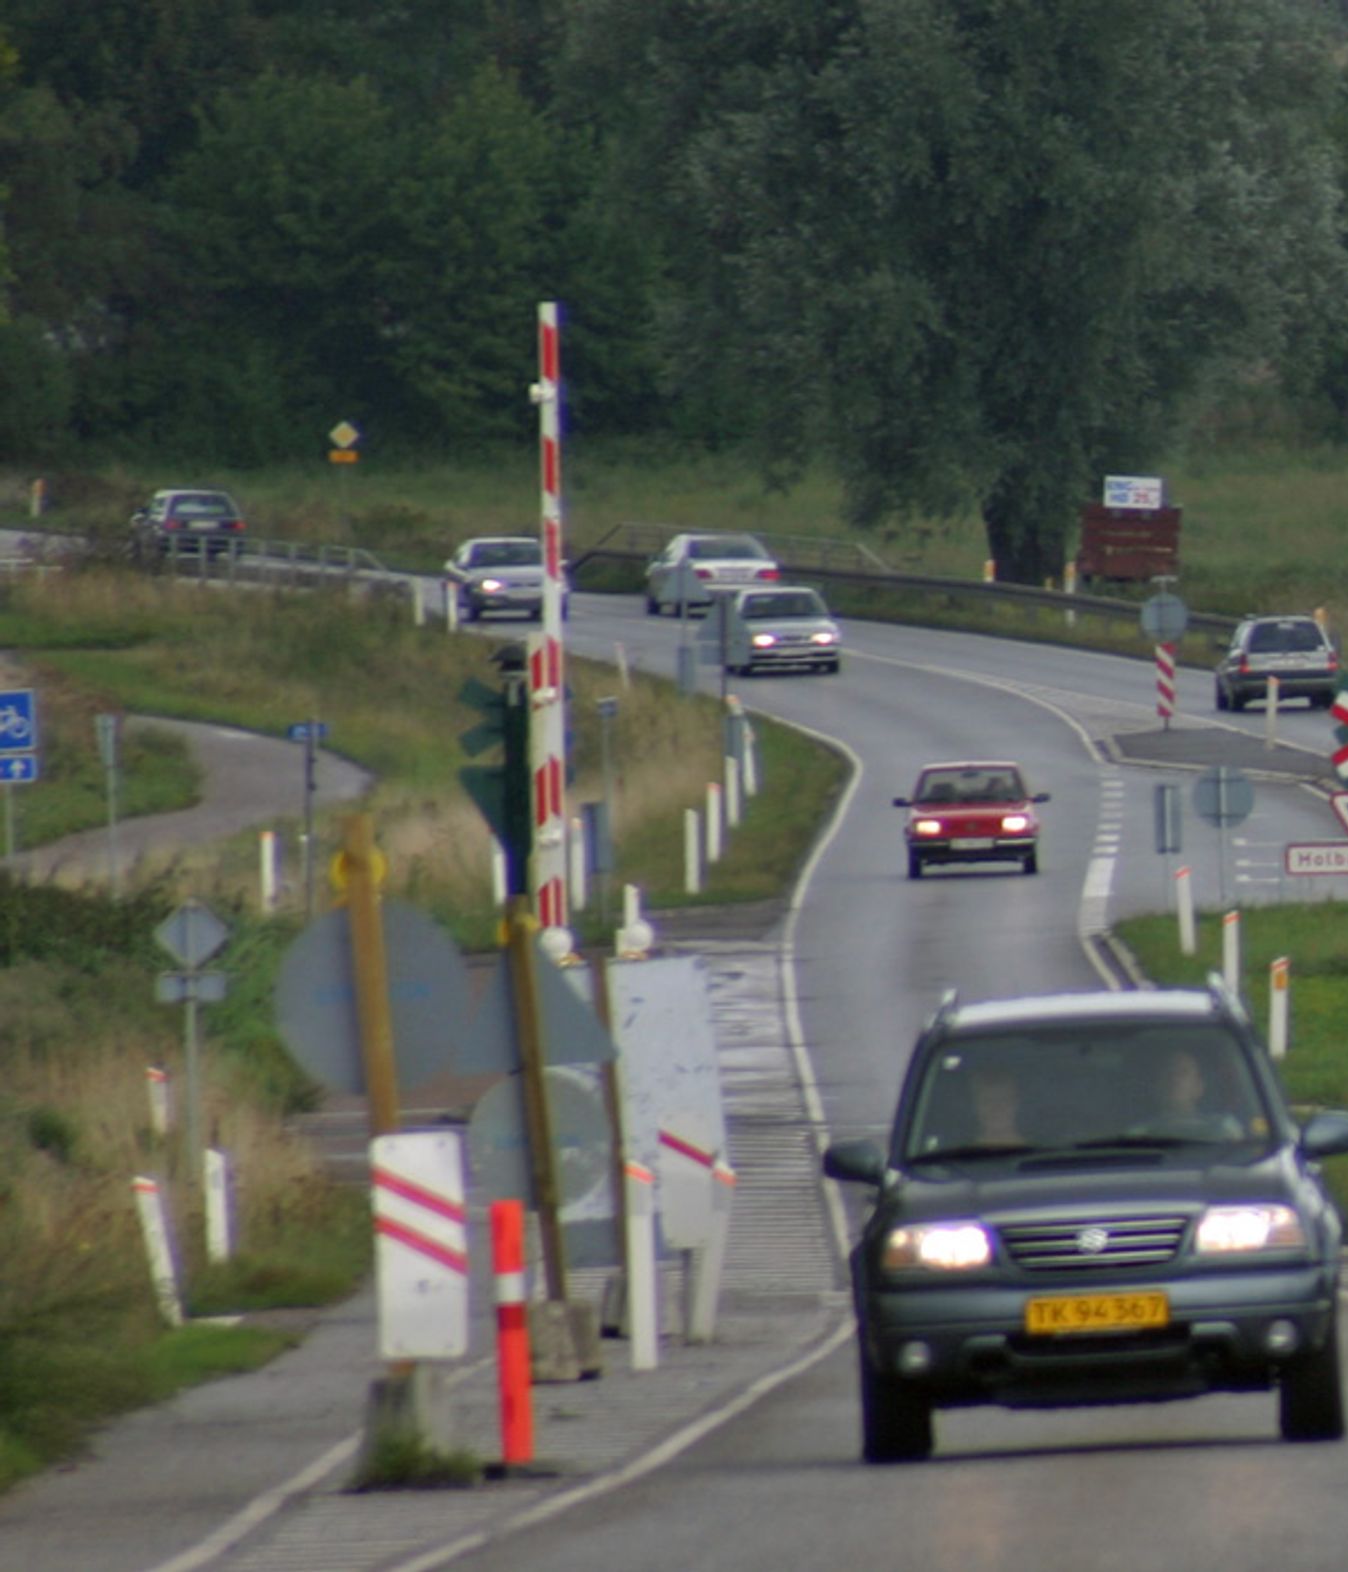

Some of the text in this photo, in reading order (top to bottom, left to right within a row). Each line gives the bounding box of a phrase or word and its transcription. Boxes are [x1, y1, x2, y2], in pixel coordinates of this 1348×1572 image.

[1033, 1296, 1164, 1324] TK 94 367
